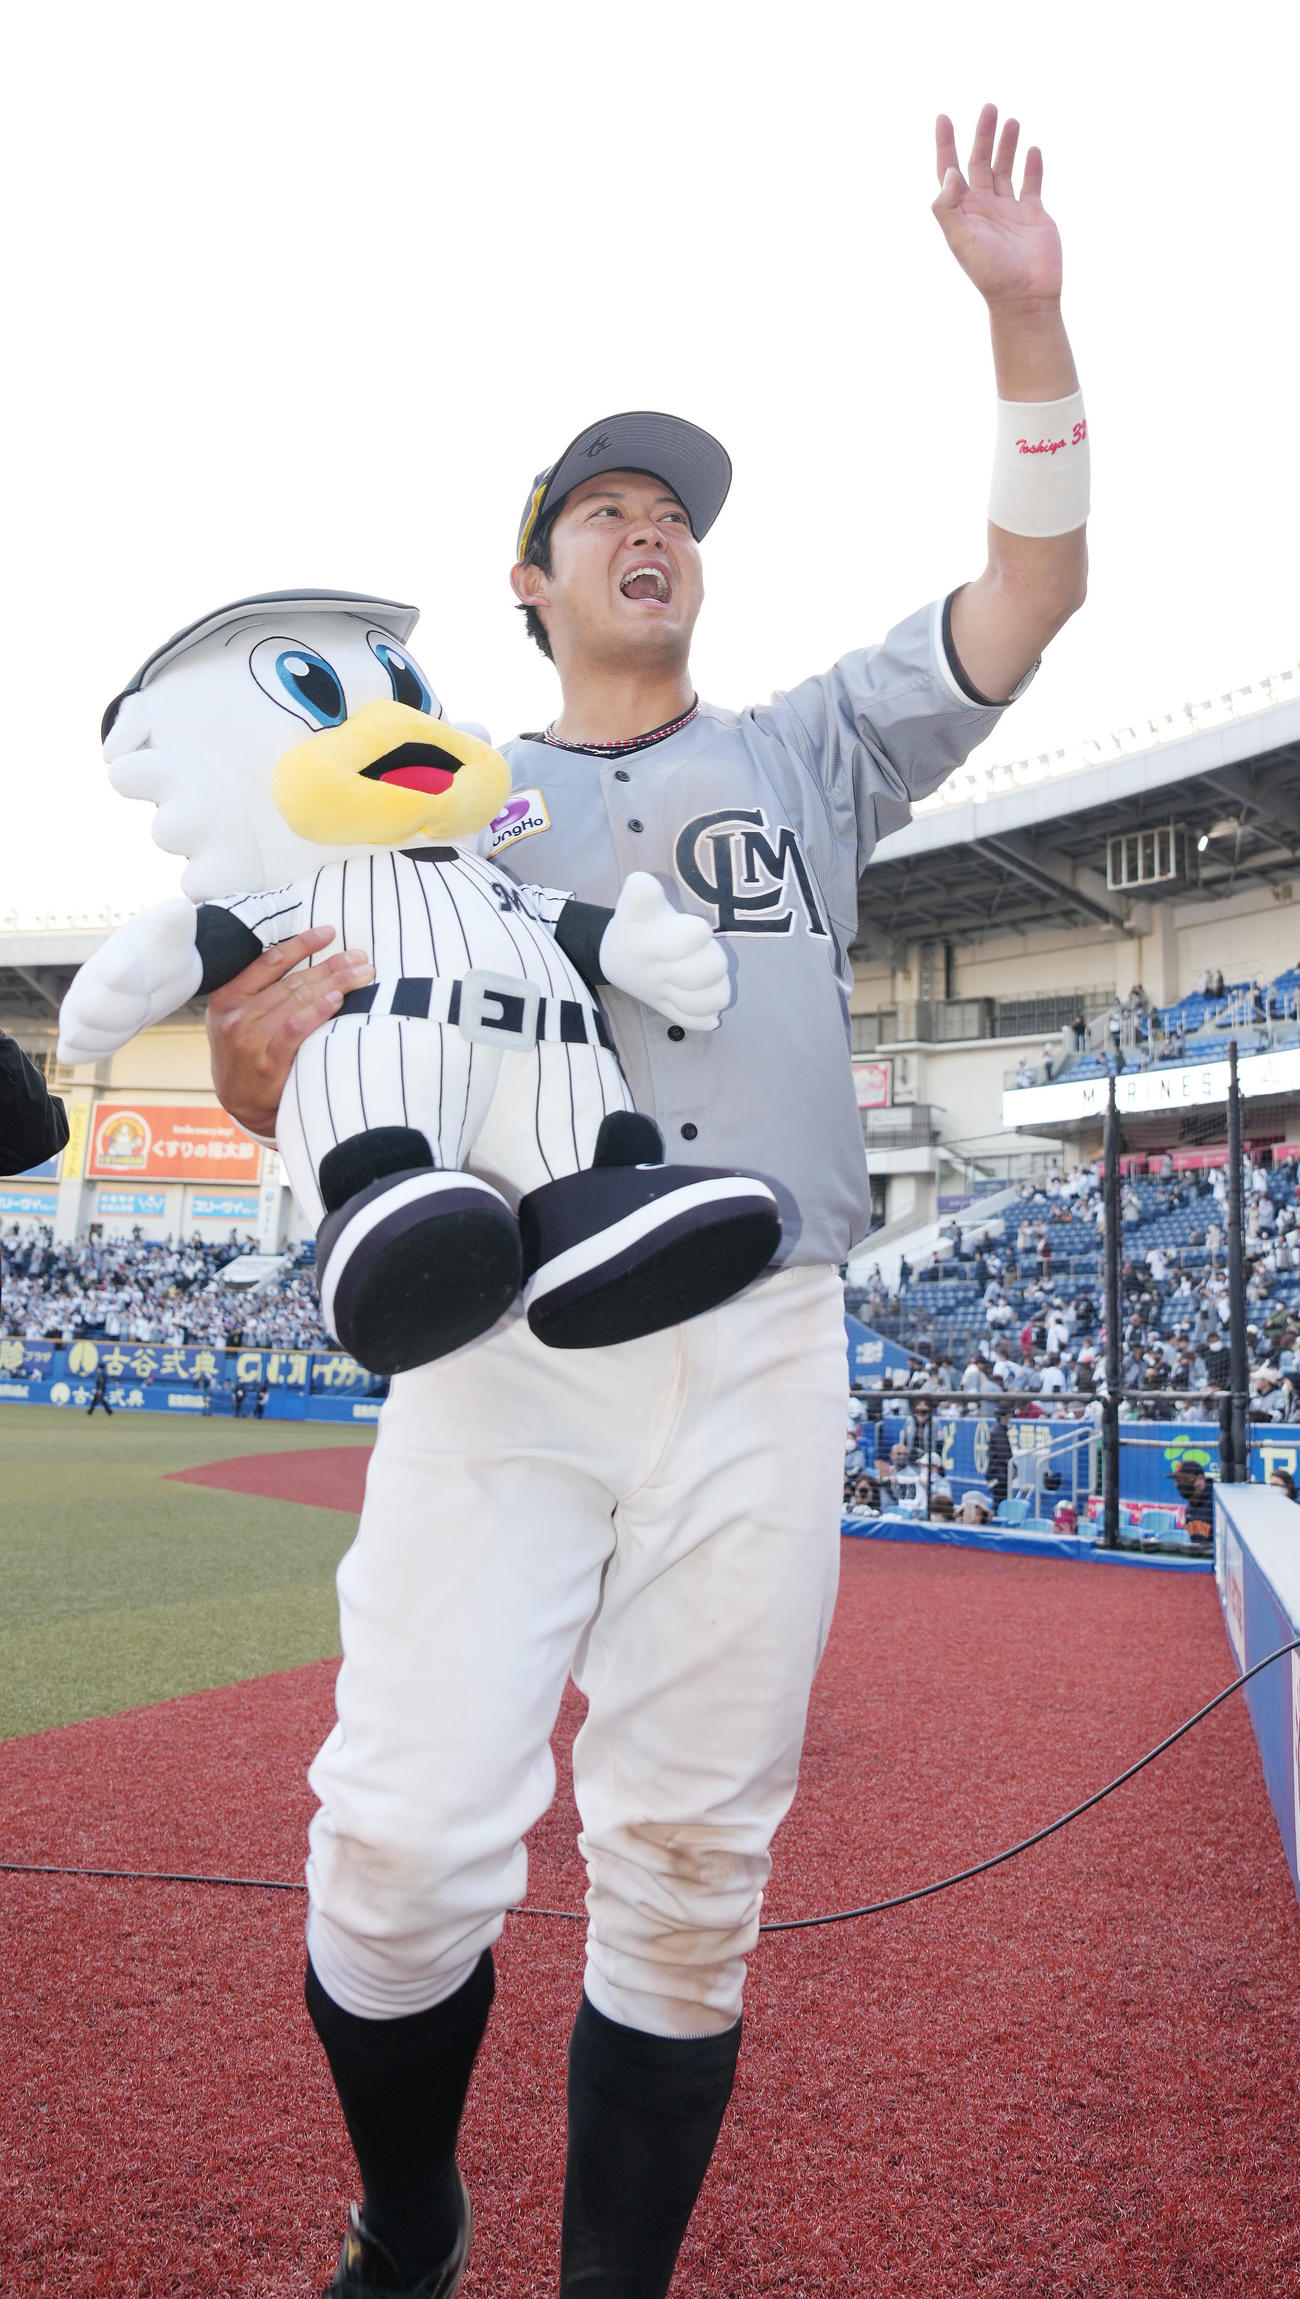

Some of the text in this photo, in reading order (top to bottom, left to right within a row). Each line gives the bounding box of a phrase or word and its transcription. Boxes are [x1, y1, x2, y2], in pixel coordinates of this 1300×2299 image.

[1016, 439, 1066, 455] Toshiya
[1082, 1071, 1213, 1104] MRINES
[102, 1346, 219, 1380] 古谷式典
[72, 1386, 145, 1407] 古式典
